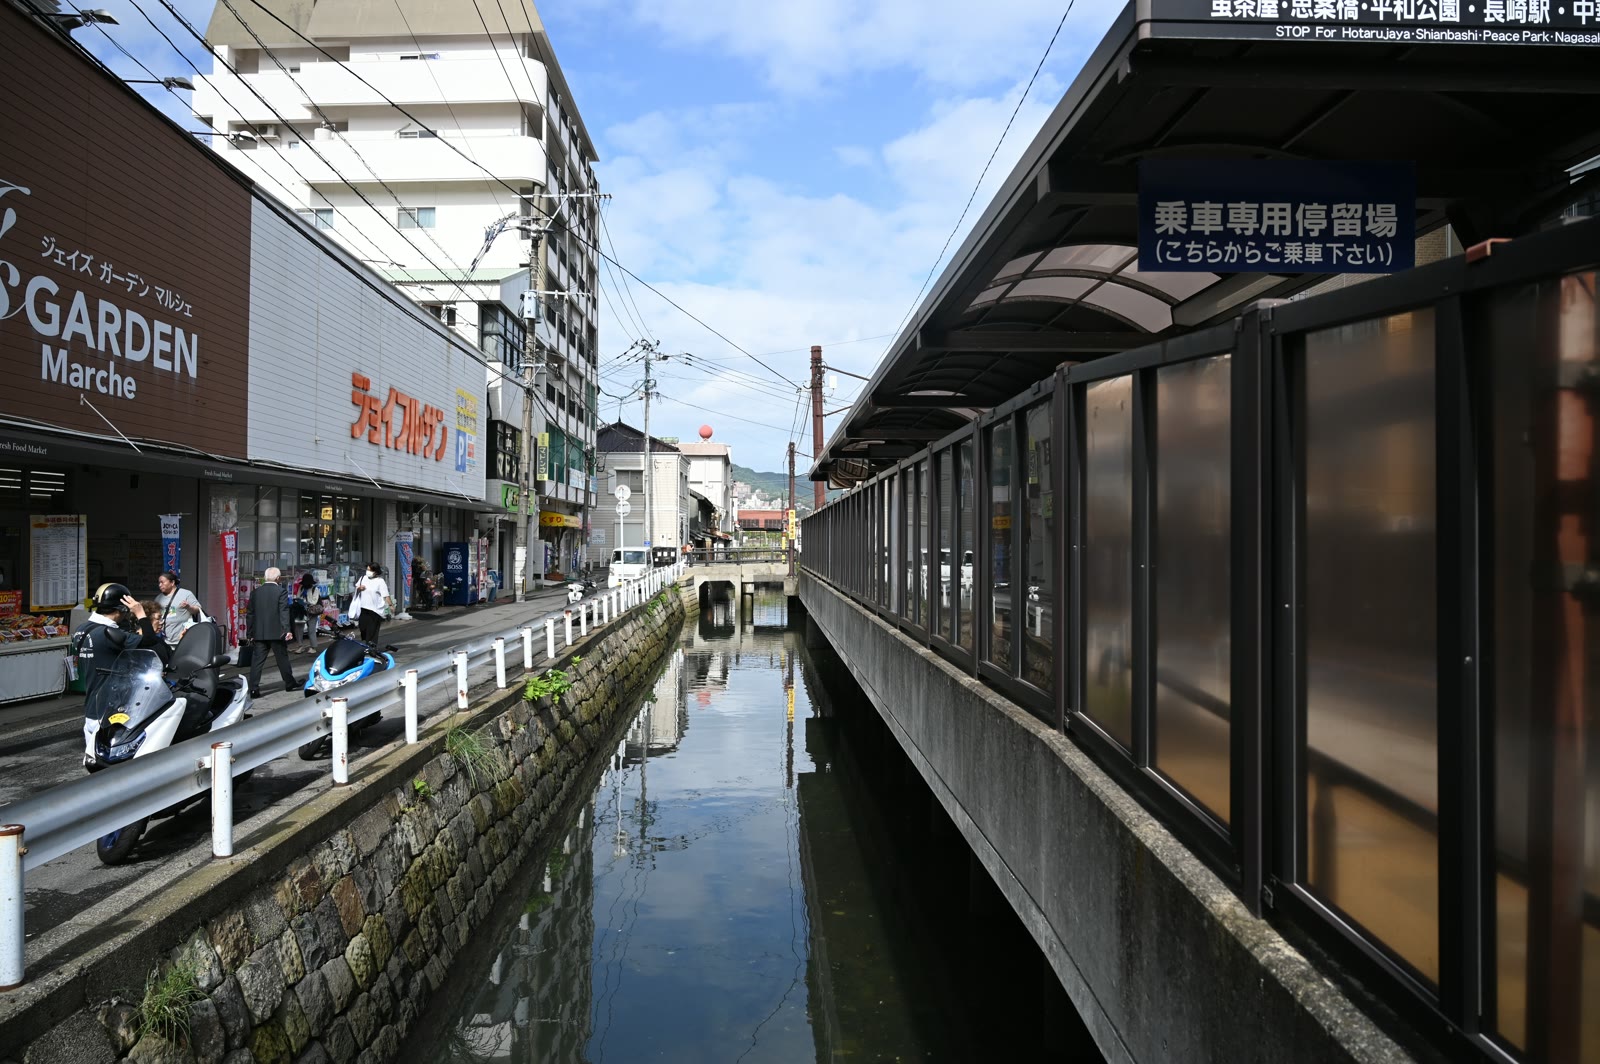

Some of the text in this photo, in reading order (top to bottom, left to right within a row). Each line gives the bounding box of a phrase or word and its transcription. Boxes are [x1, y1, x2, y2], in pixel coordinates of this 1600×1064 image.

[1275, 26, 1310, 38] STOP
[1315, 27, 1337, 38] For
[1154, 200, 1398, 238] 乗車専用停留場
[41, 235, 193, 318] ジェイズ ガーデン マルシェ
[25, 275, 198, 380] GARDEN
[41, 343, 137, 400] Marche
[12, 442, 27, 452] Food
[27, 444, 47, 455] Market
[458, 435, 465, 466] P
